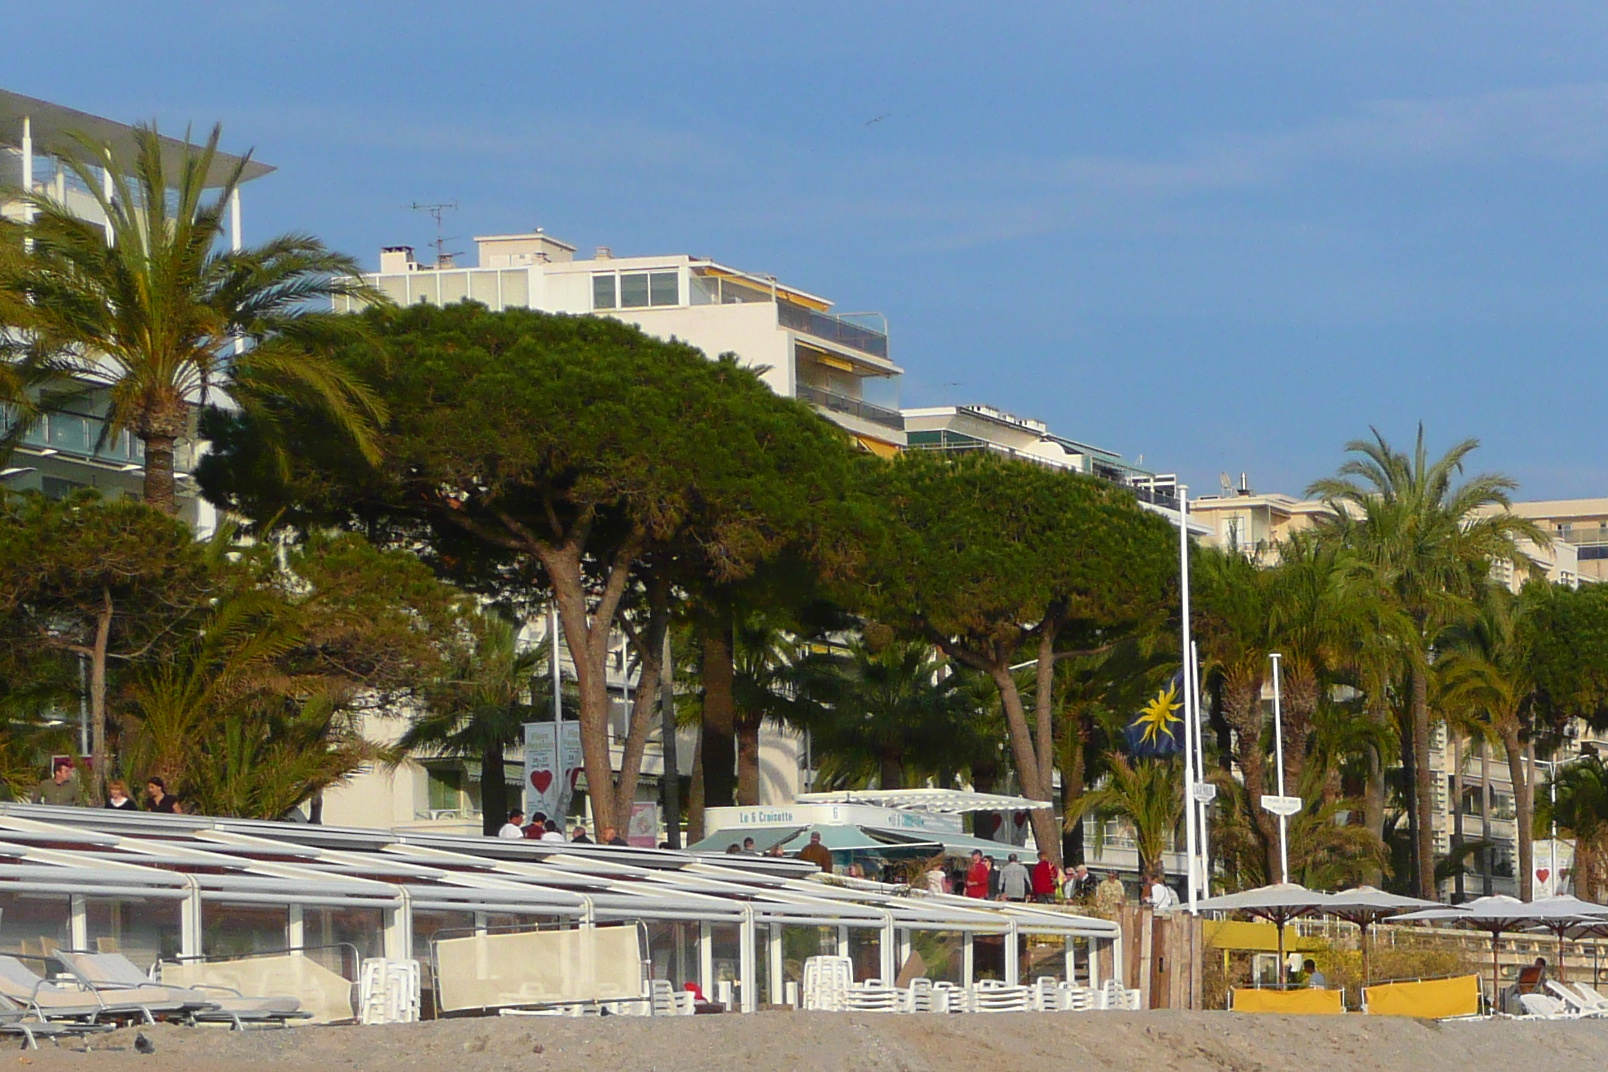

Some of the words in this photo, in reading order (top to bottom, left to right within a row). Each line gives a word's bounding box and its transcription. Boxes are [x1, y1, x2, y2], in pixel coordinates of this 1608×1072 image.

[740, 812, 749, 823] Le
[751, 811, 756, 823] 6
[759, 811, 793, 823] Croisette
[833, 807, 839, 819] 6
